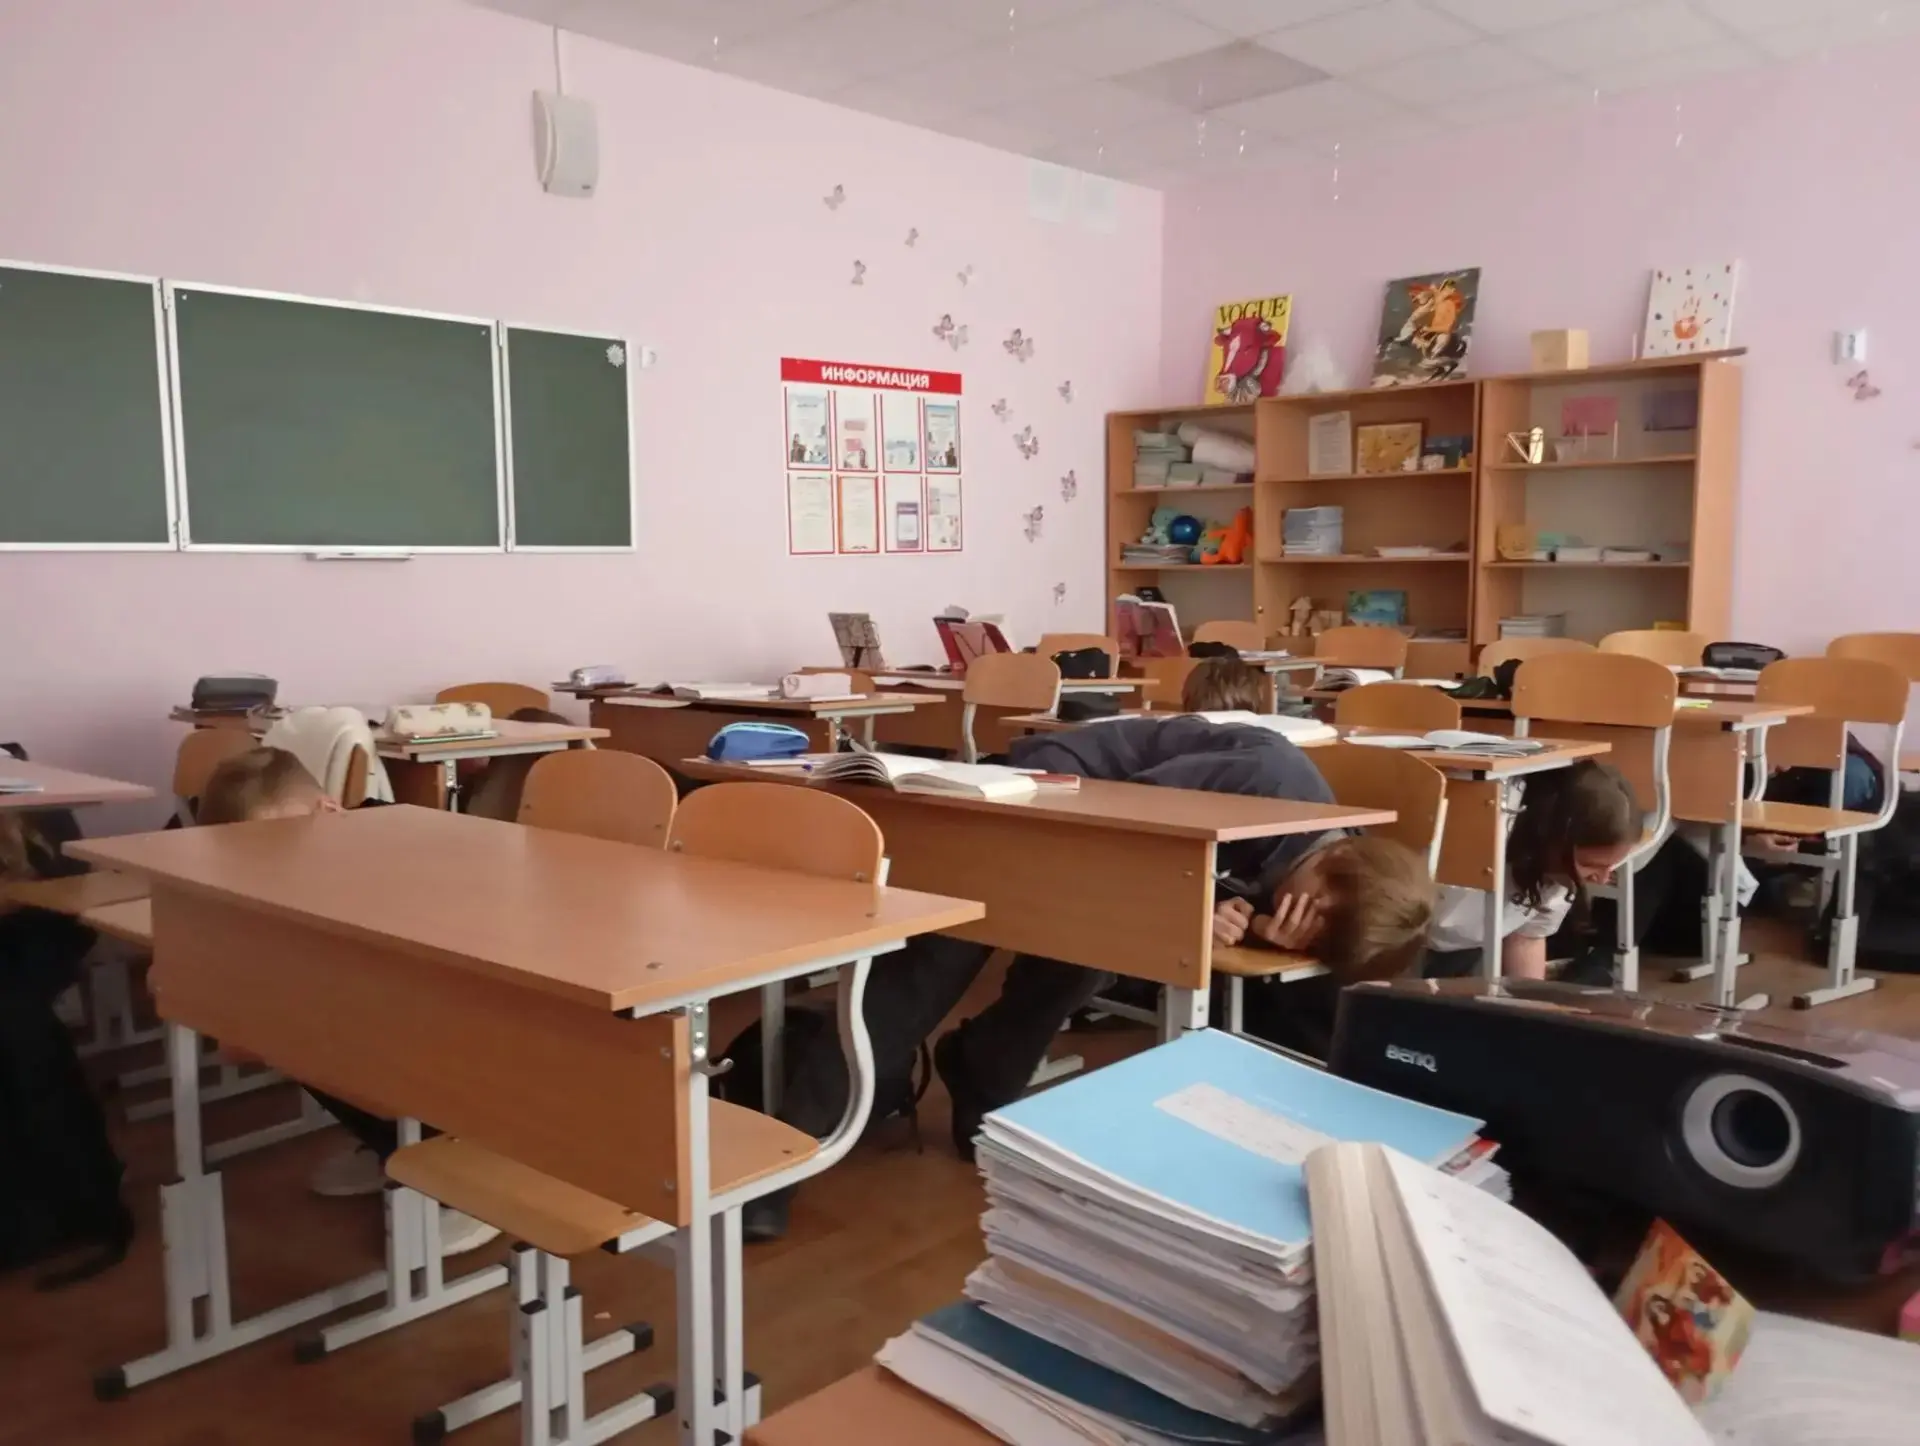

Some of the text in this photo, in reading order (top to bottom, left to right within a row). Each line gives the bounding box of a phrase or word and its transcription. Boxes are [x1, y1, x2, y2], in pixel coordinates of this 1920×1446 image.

[1219, 296, 1288, 324] VOGUE
[821, 365, 930, 391] ИНФОРМАЦИЯ
[1385, 1044, 1438, 1073] BenQ
